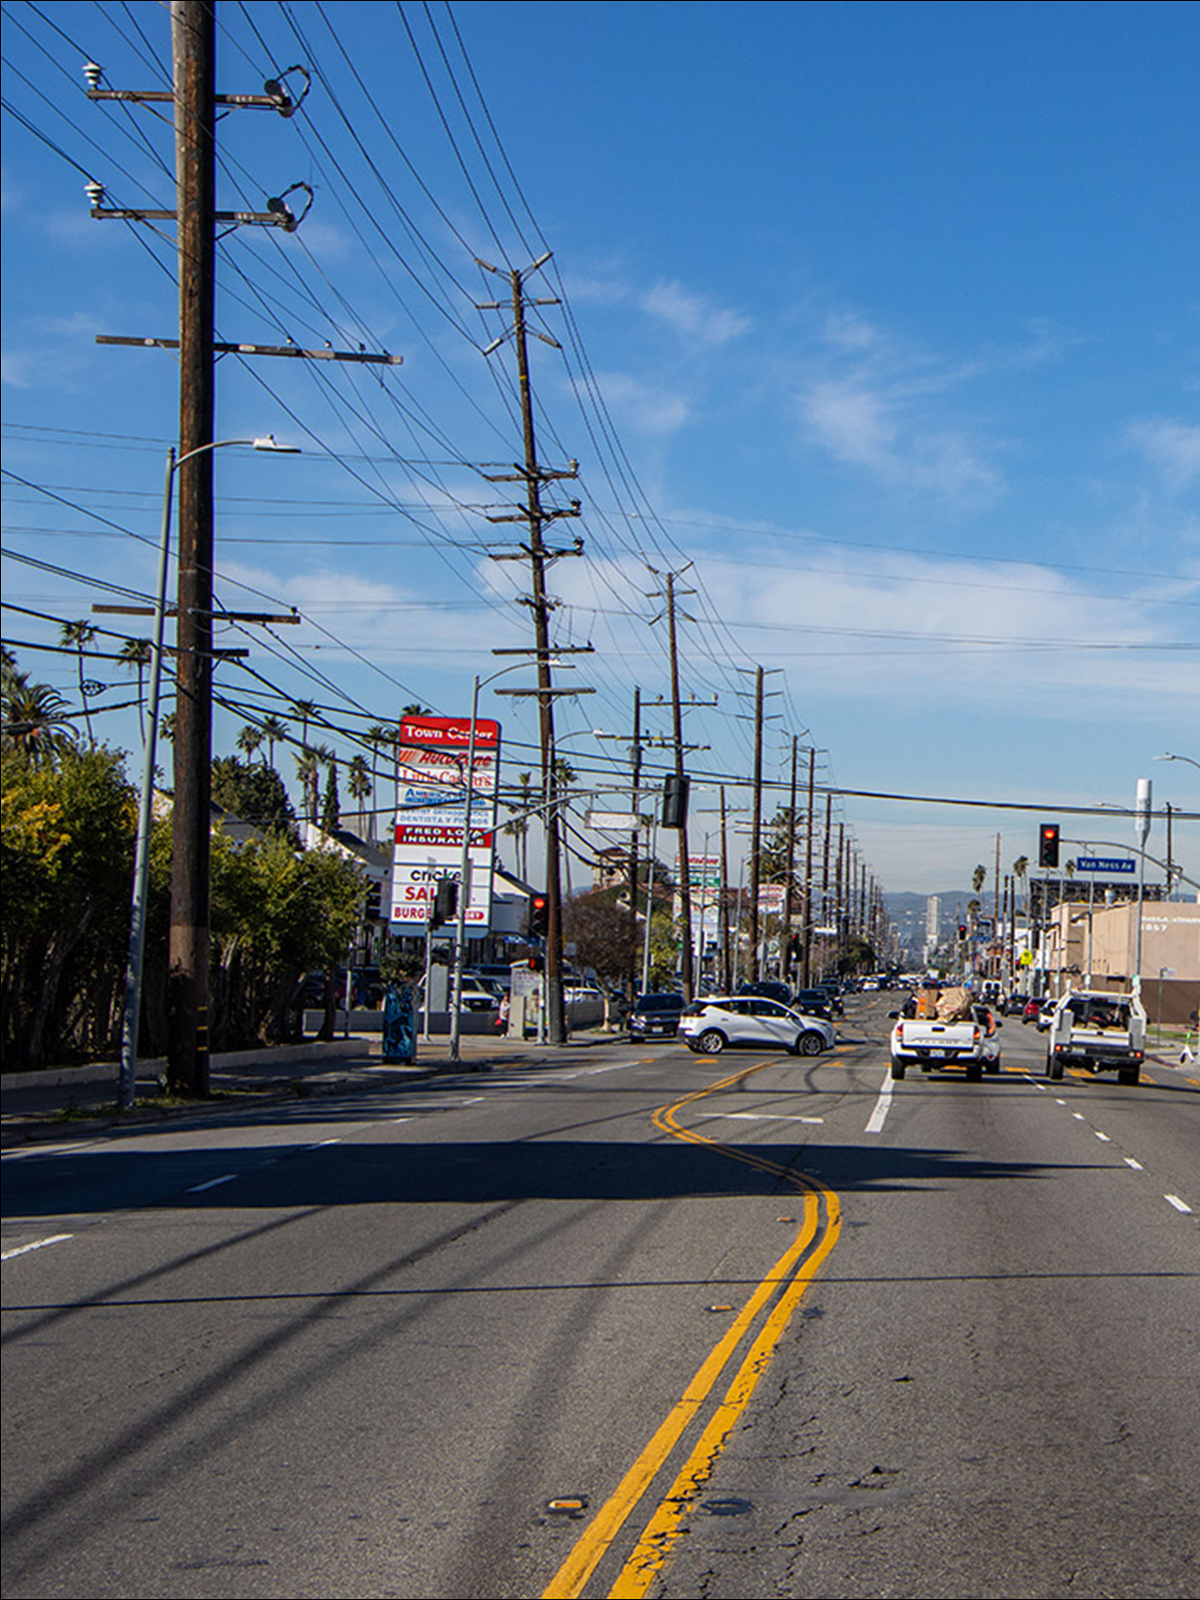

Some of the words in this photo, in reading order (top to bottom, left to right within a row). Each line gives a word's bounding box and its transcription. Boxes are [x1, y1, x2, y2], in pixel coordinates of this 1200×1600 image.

[404, 725, 443, 738] Town
[453, 817, 489, 825] FRNOS
[405, 827, 442, 836] FRED
[1080, 860, 1094, 869] Van
[1098, 861, 1119, 870] Ness
[1121, 862, 1133, 870] Av
[410, 868, 463, 881] cricke
